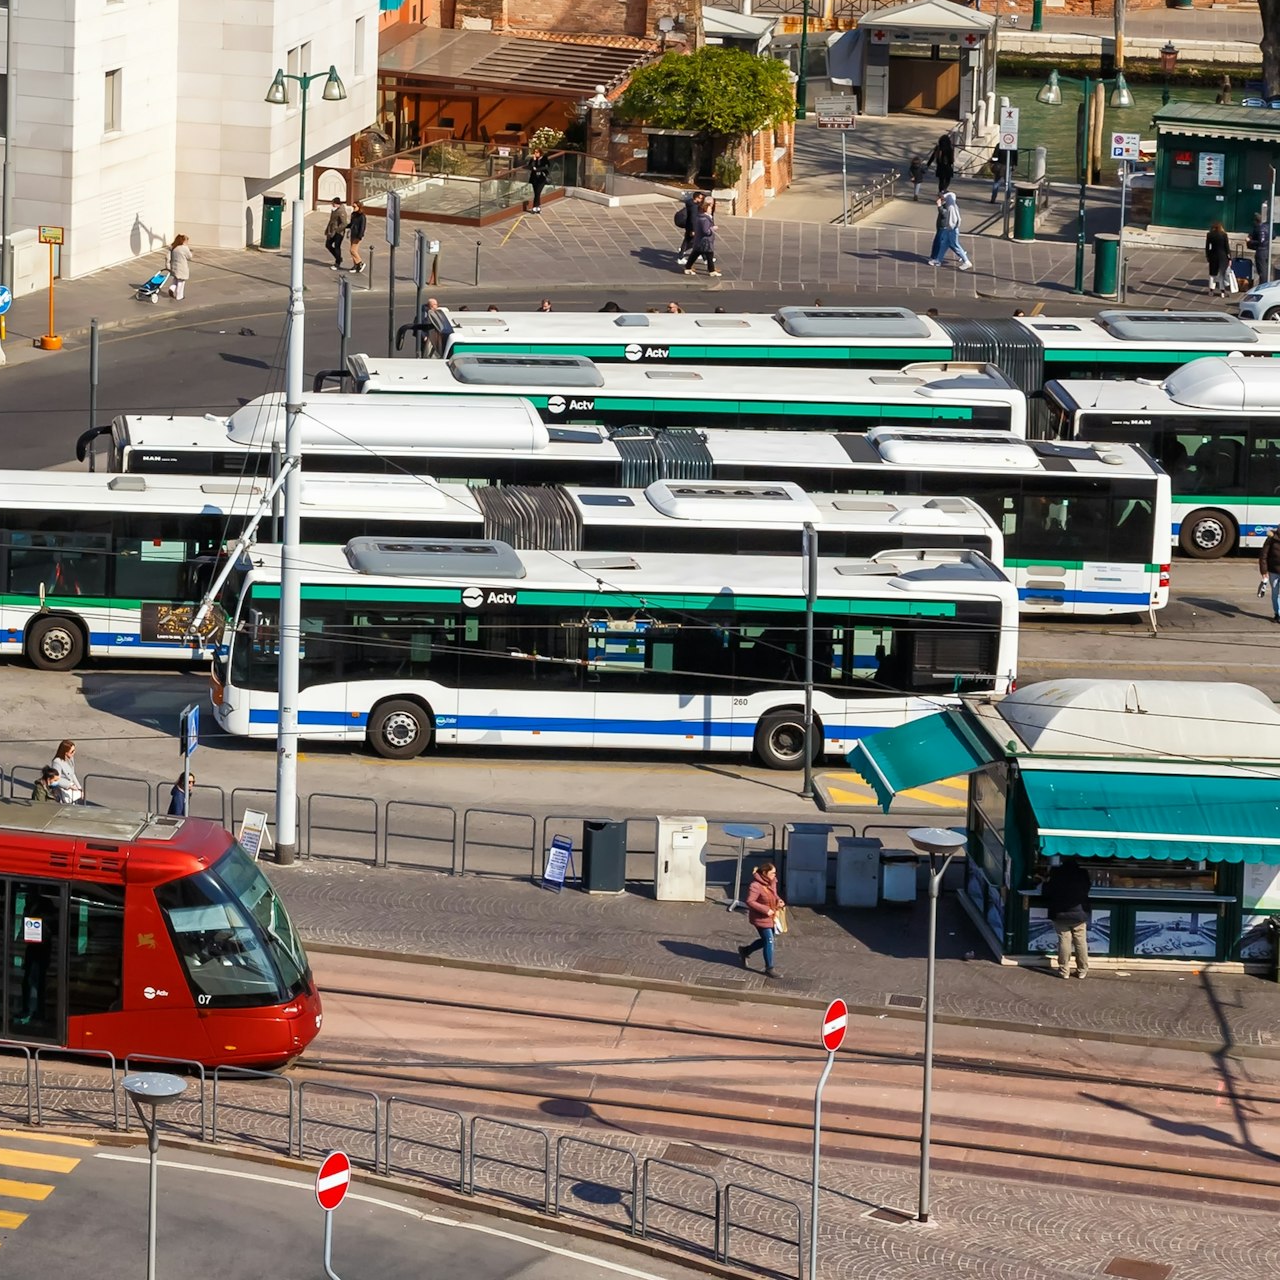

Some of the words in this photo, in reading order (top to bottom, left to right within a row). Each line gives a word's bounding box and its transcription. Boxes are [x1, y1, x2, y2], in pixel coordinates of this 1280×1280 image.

[363, 176, 415, 192] PARKING
[645, 347, 669, 358] Actv
[569, 400, 594, 410] Actv
[487, 592, 517, 604] Actv
[198, 994, 212, 1005] 07
